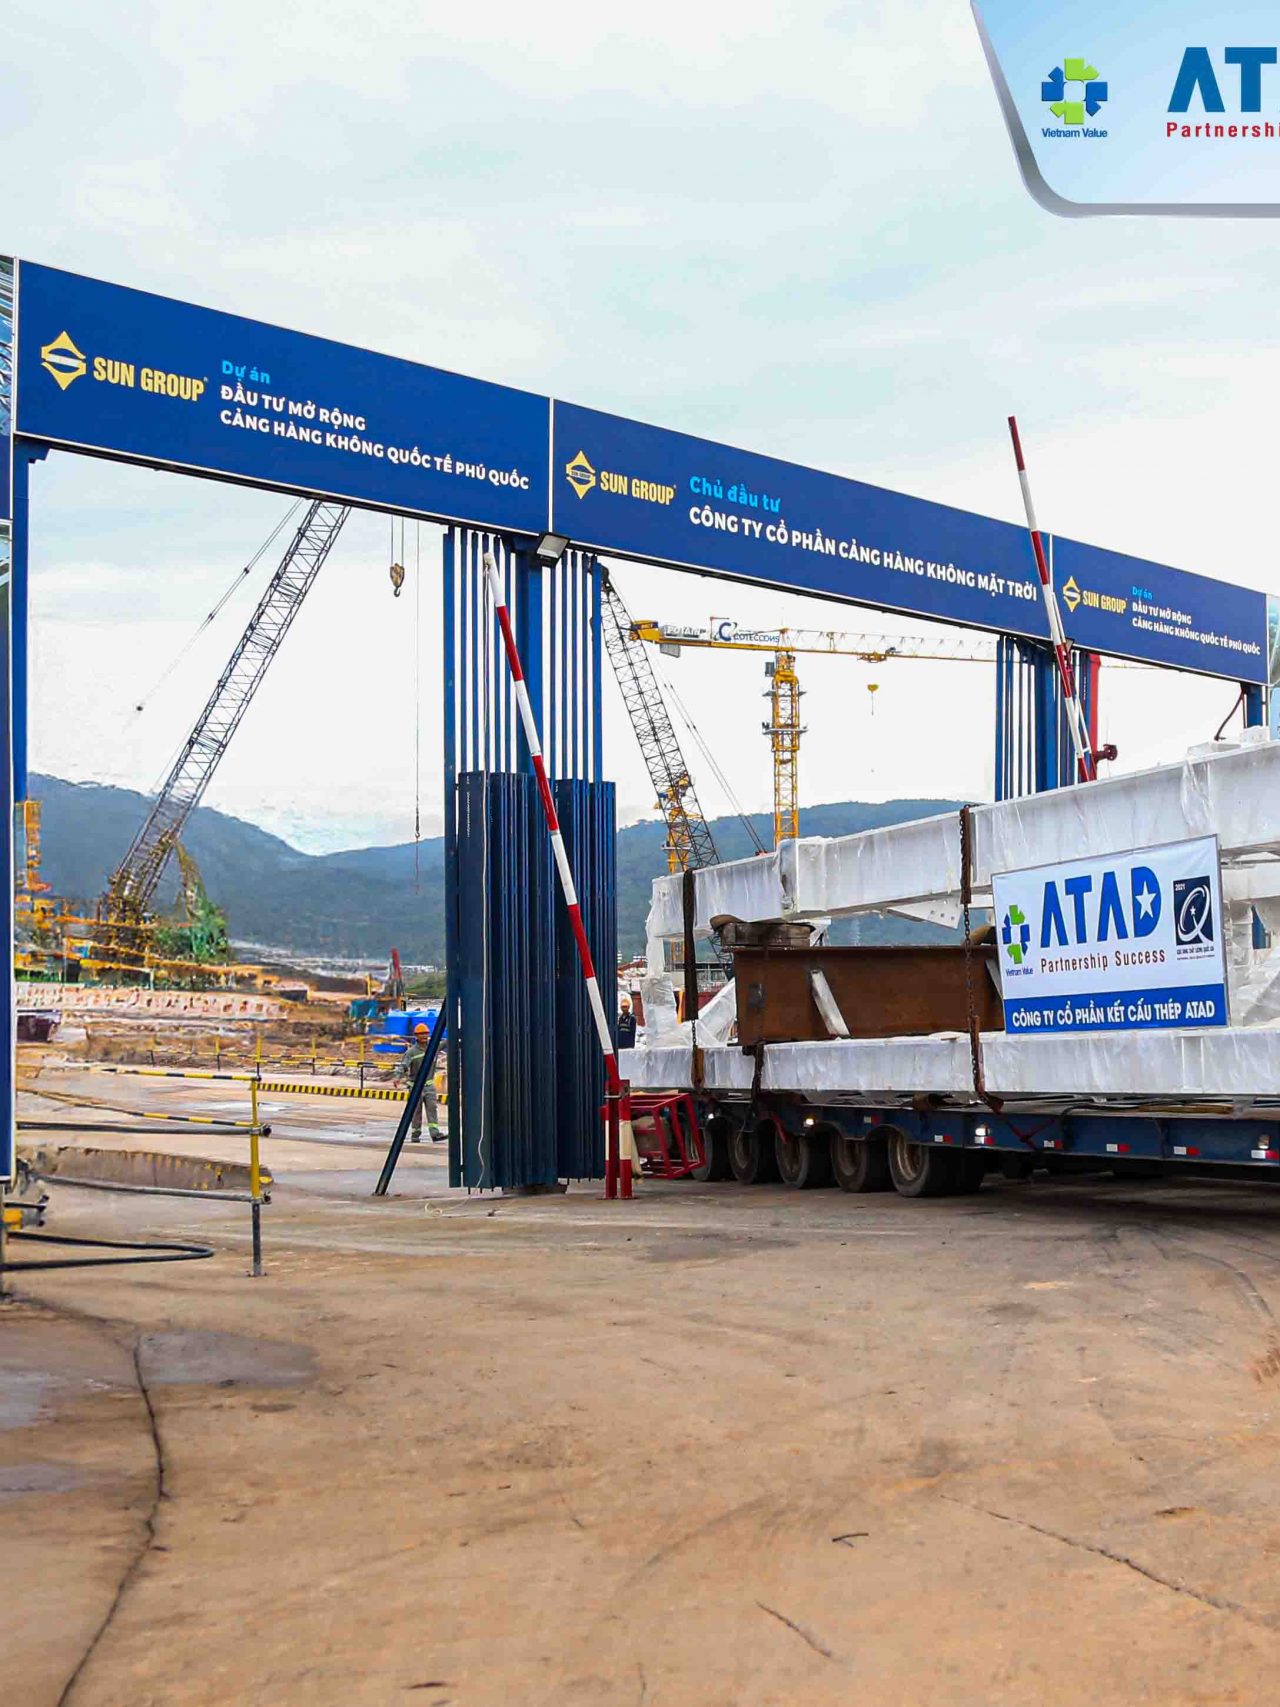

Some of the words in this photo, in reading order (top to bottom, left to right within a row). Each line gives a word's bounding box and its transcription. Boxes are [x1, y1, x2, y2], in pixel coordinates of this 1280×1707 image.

[93, 356, 135, 389] SUN
[140, 367, 205, 402] GROUP
[221, 359, 246, 382] Dự
[249, 366, 271, 385] án
[220, 381, 258, 407] ĐẦU
[261, 394, 286, 413] TƯ
[288, 400, 316, 420] MỞ
[319, 407, 366, 431] RỘNG
[220, 407, 270, 433] CẢNG
[273, 420, 322, 445] HÀNG
[325, 433, 384, 458] KHÔNG
[387, 446, 431, 468] QUỐC
[434, 453, 453, 474] TẾ
[455, 461, 486, 480] PHÚ
[488, 468, 529, 490] QUỐC
[600, 470, 628, 496] SUN
[631, 478, 675, 506] GROUP
[689, 475, 723, 499] Chủ
[727, 483, 758, 508] đầu
[762, 494, 781, 513] tư
[689, 505, 739, 533] CÔNG
[742, 518, 763, 539] TY
[765, 519, 789, 545] CỔ
[791, 528, 836, 556] PHẦN
[838, 538, 881, 566] CẢNG
[883, 551, 924, 576] HÀNG
[927, 563, 975, 587] KHÔNG
[977, 572, 1005, 597] MẶT
[1006, 580, 1037, 601] TRỜI
[1082, 590, 1100, 609] SUN
[1100, 594, 1127, 615] GROUP
[1132, 586, 1142, 598] Dự
[1143, 589, 1153, 600] án
[1148, 606, 1159, 617] TƯ
[1160, 607, 1171, 620] MỞ
[1172, 611, 1192, 626] RỘNG
[1132, 616, 1153, 631] CẢNG
[1154, 621, 1174, 635] HÀNG
[1174, 627, 1200, 641] KHÔNG
[1200, 631, 1219, 646] QUỐC
[1242, 642, 1261, 655] QUỐC
[1040, 866, 1162, 949] ATAD
[1005, 968, 1022, 977] Vietnam
[1022, 966, 1034, 976] Value
[1040, 953, 1108, 972] Partnership
[1115, 949, 1166, 967] Success
[1012, 1007, 1041, 1027] CÔNG
[1043, 1010, 1054, 1026] TY
[1056, 1000, 1073, 1025] CỔ
[1075, 1000, 1105, 1024] PHẦN
[1107, 999, 1125, 1023] KẾT
[1128, 998, 1152, 1022] CẤU
[1154, 998, 1182, 1020] THÉP
[1185, 1000, 1216, 1019] ATAD
